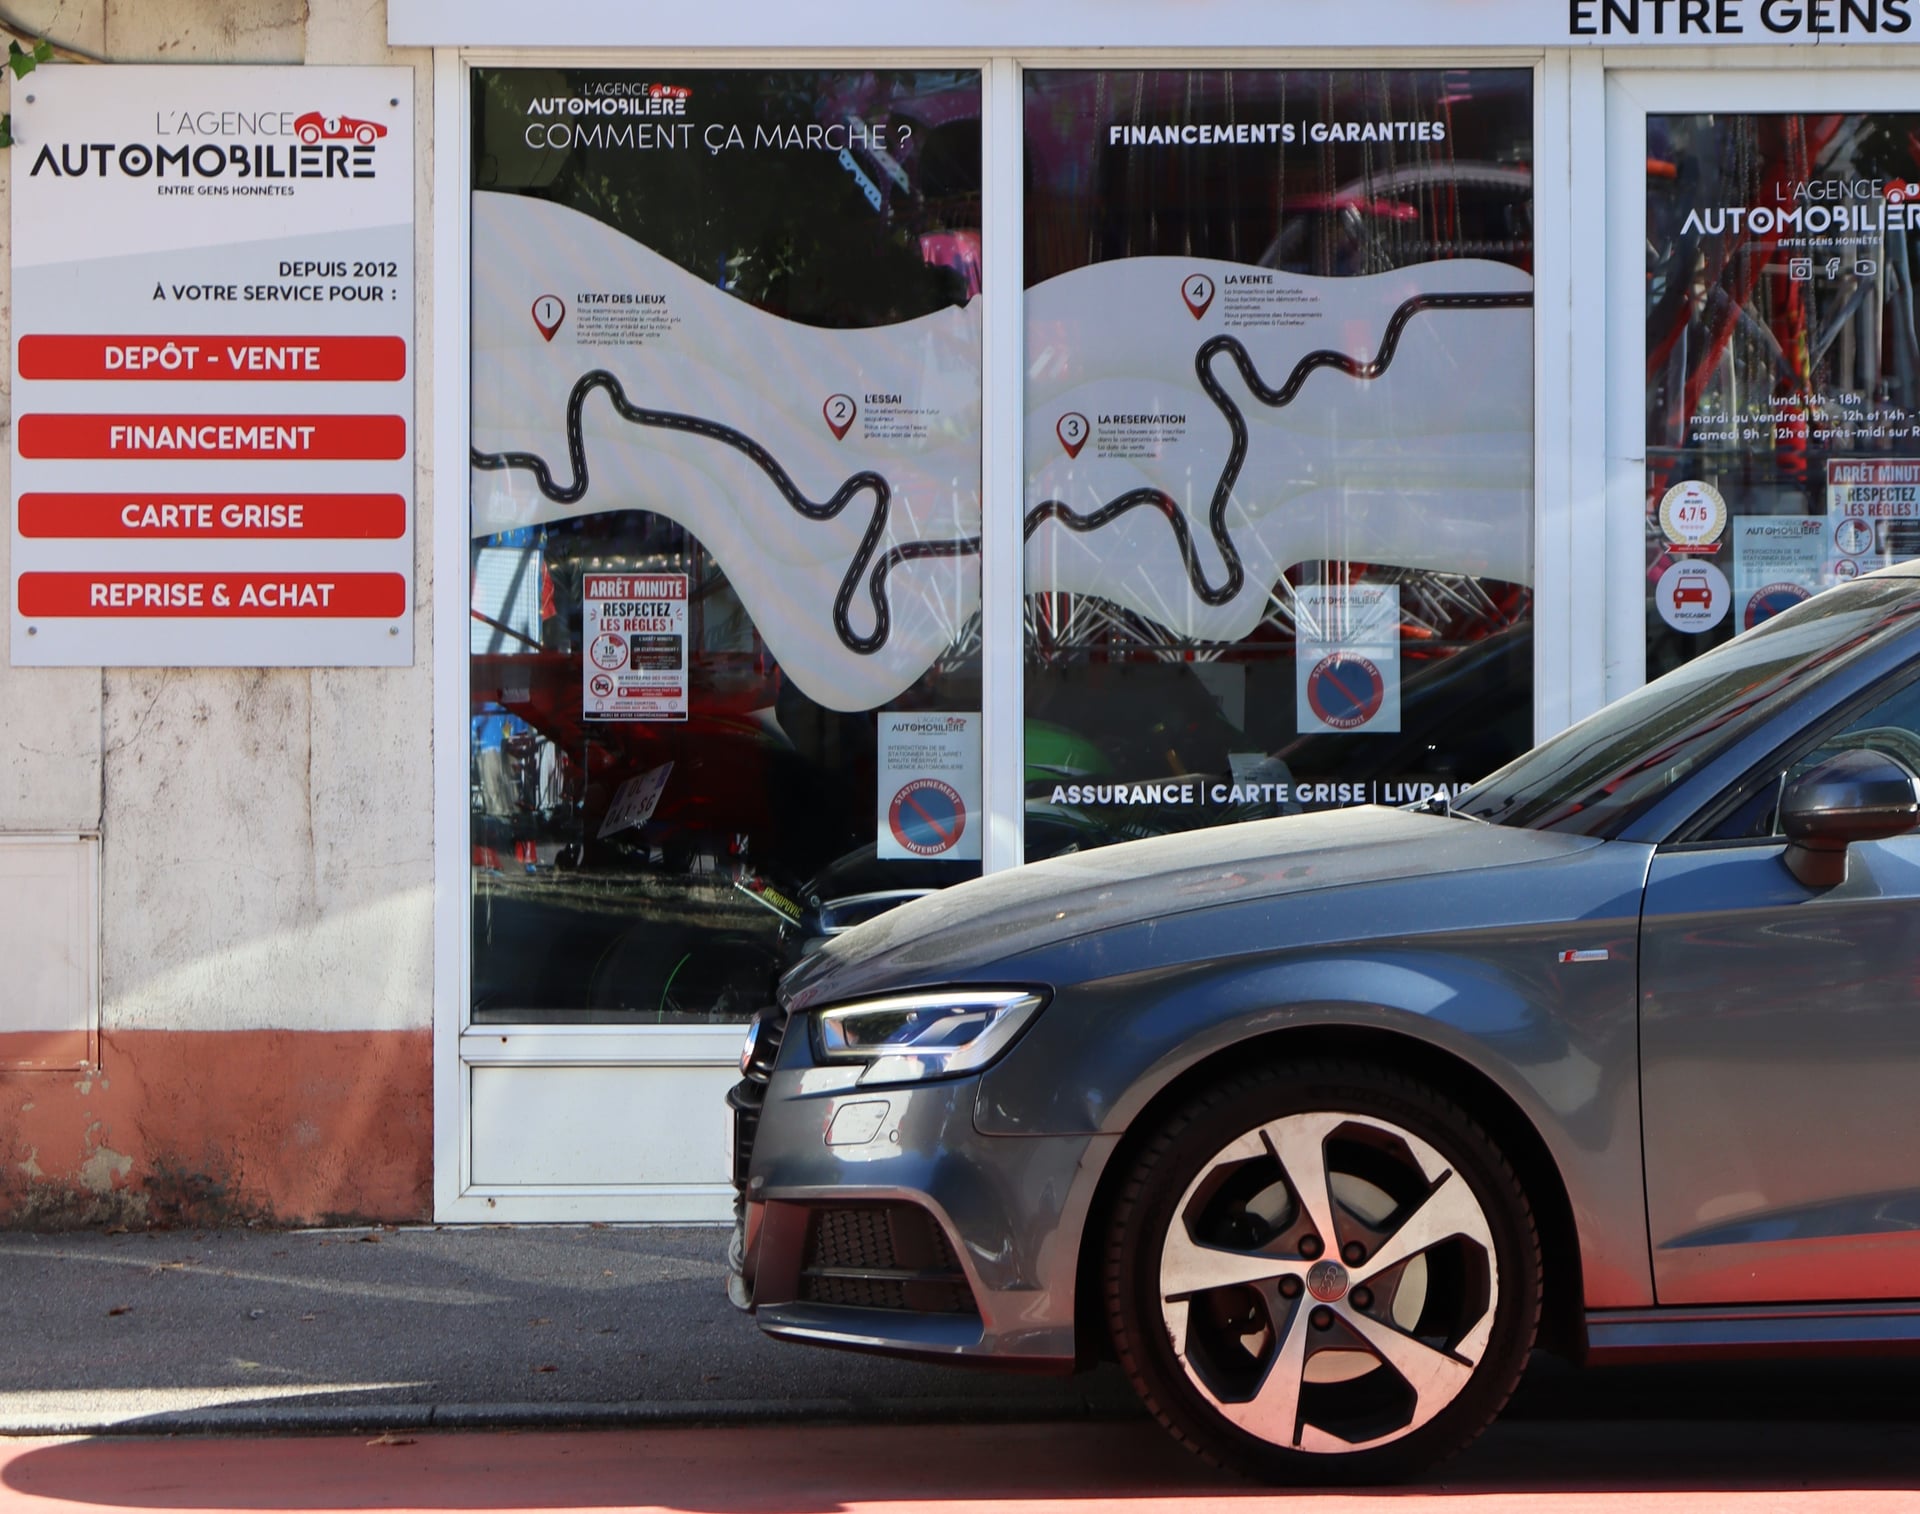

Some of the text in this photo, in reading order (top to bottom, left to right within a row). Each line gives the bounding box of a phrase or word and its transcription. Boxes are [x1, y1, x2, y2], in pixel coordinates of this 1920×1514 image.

[1569, 0, 1912, 35] ENTRE GENS
[584, 82, 649, 97] L'AGENCE
[156, 112, 295, 136] L'AGENCE
[525, 123, 912, 156] COMMENT ÇA MARCHE ?
[1109, 121, 1446, 145] FINANCEMENTS GARANTIES
[157, 183, 295, 196] ENTRE GENS HONNÊTES
[1776, 179, 1883, 201] L'AGENCE
[1778, 238, 1806, 248] ENTRE
[1809, 237, 1833, 246] GENS
[279, 262, 398, 278] DEPUIS 2012
[1224, 275, 1273, 284] LA VENTE
[152, 282, 167, 301] À
[172, 285, 238, 301] VOTRE
[243, 285, 324, 301] SERVICE
[329, 286, 384, 301] POUR
[1192, 281, 1204, 298] 4
[577, 294, 666, 304] L'ETAT DES LIEUX
[545, 303, 550, 319] 1
[104, 342, 200, 370] DEPÔT
[227, 346, 321, 371] VENTE
[865, 394, 902, 404] L'ESSAI
[1768, 394, 1800, 406] lundi
[1803, 394, 1825, 405] 14h
[1839, 394, 1861, 405] 18h
[835, 402, 846, 418] 2
[1690, 412, 1729, 424] mardi
[1733, 414, 1748, 424] au
[1752, 411, 1809, 423] vendredi
[1812, 411, 1829, 422] 9h
[1843, 410, 1864, 421] 12h
[1867, 410, 1880, 421] et
[1883, 409, 1905, 420] 14h
[1098, 414, 1186, 424] LA RESERVATION
[1068, 420, 1079, 436] 3
[1692, 429, 1740, 441] samedi
[1743, 428, 1760, 440] 9h
[1774, 428, 1794, 439] 12h
[1797, 427, 1810, 439] et
[1812, 426, 1885, 441] après-midi
[1888, 428, 1909, 438] sur
[109, 425, 316, 450] FINANCEMENT
[1834, 462, 1874, 482] ARRÊT
[1847, 487, 1916, 502] RESPECTEZ
[121, 504, 304, 528] CARTE GRISE
[1845, 503, 1864, 516] LES
[90, 583, 335, 607] REPRISE & ACHAT
[590, 577, 682, 598] ARRÊT MINUTE
[603, 602, 671, 617] RESPECTEZ
[600, 618, 621, 632] LES
[604, 646, 614, 655] 15
[1325, 714, 1365, 727] INTERDIT
[894, 780, 960, 805] STATIONNEMENT
[1051, 784, 1193, 804] ASSURANCE
[1211, 783, 1289, 803] CARTE
[1296, 783, 1365, 802] GRISE
[906, 841, 947, 854] INTERDIT
